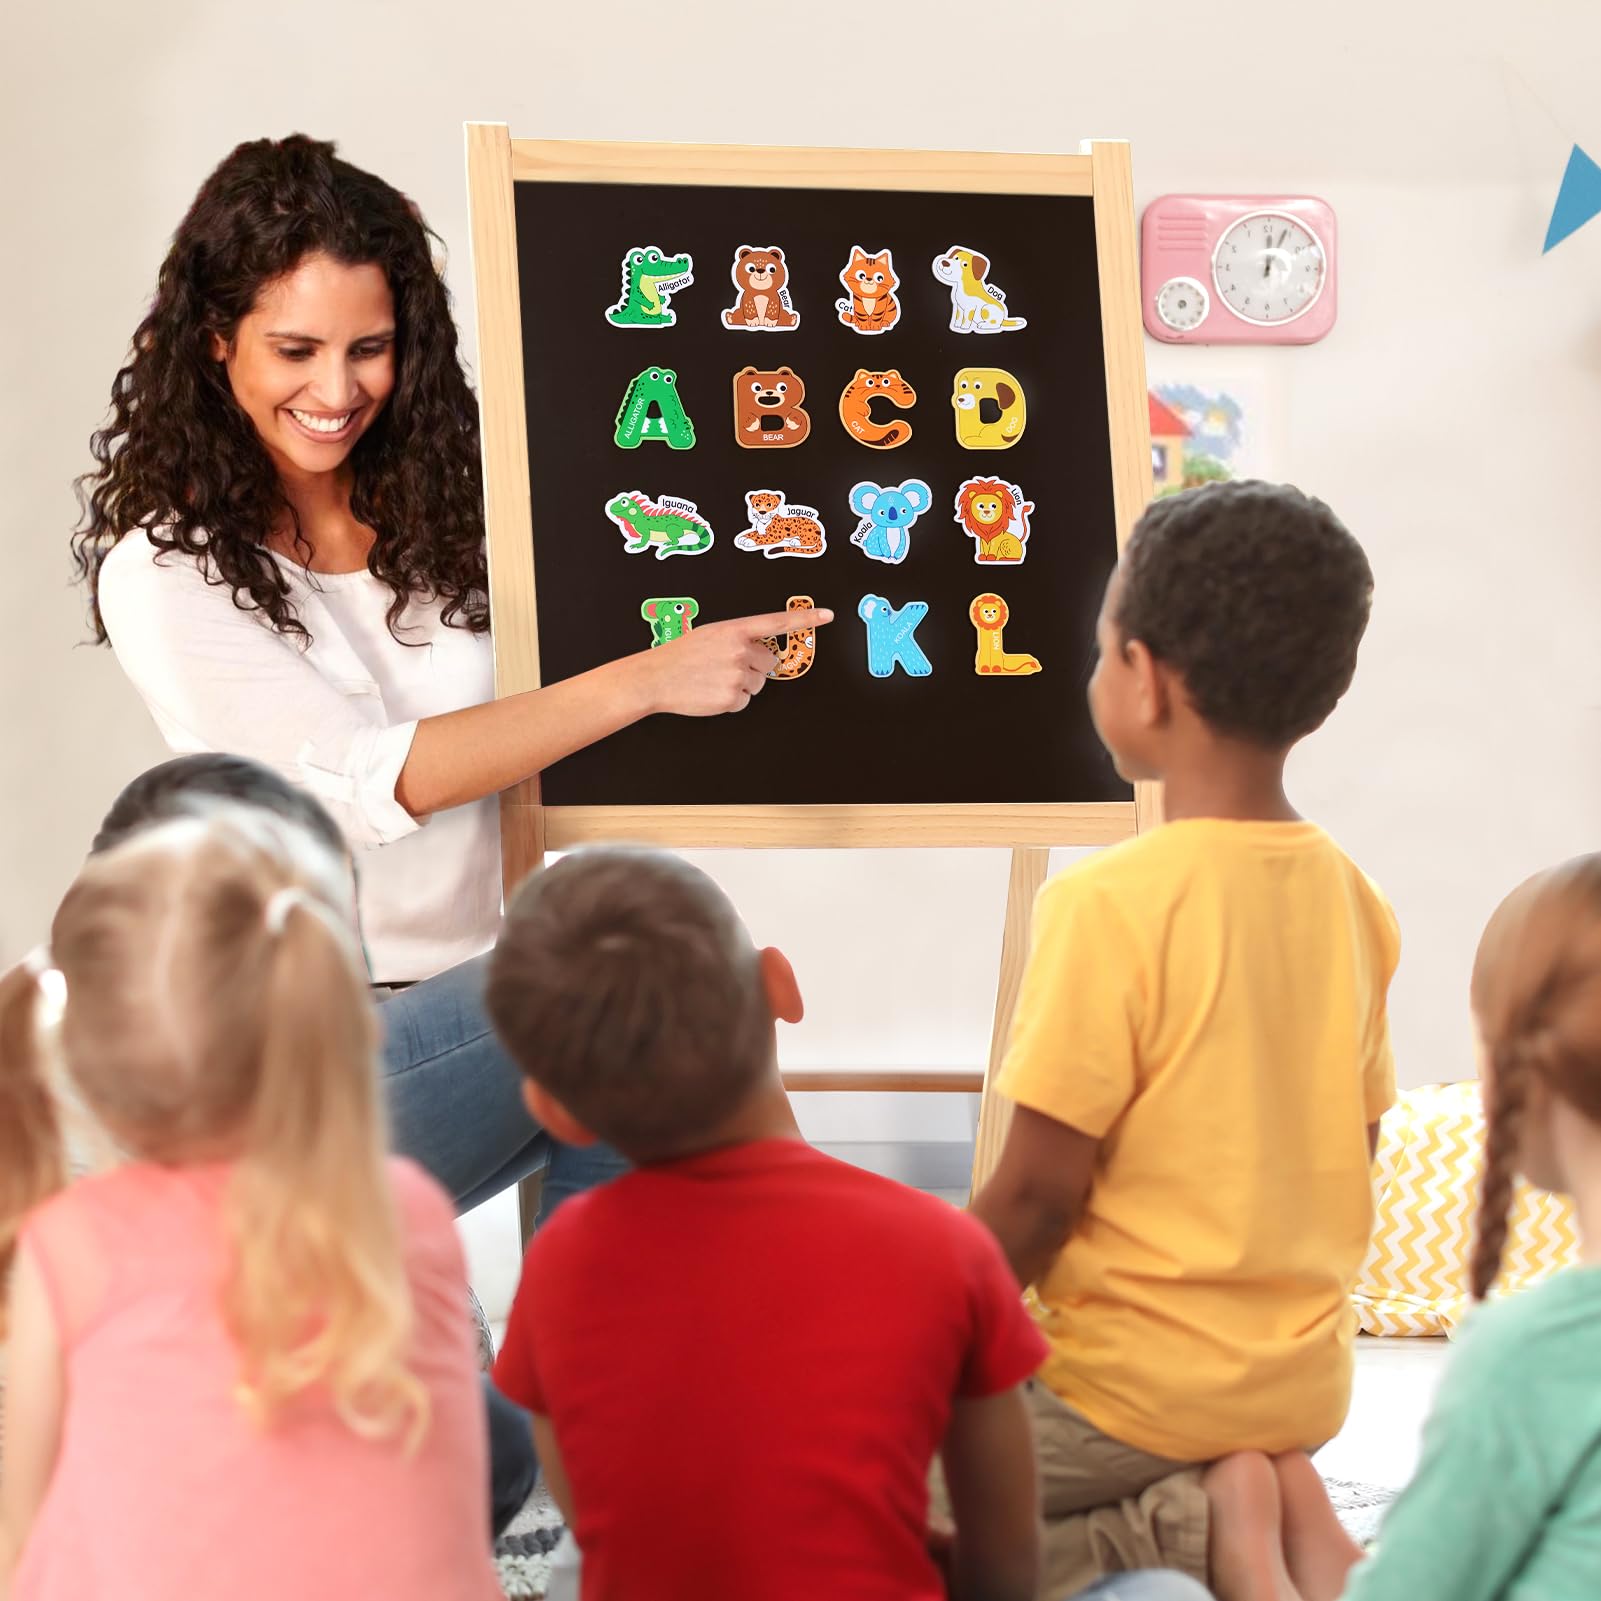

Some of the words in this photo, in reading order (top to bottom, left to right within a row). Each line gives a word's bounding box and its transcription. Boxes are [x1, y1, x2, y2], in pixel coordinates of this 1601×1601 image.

[658, 276, 690, 292] Alligator
[780, 289, 790, 308] Bear
[987, 286, 1003, 301] Dog
[838, 301, 853, 312] Cat
[624, 397, 645, 439] ALLIGATOR
[851, 420, 865, 434] CAT
[763, 433, 784, 441] BEAR
[1011, 488, 1022, 506] Lion
[662, 498, 694, 513] Iguana
[787, 507, 816, 518] Jaguar
[853, 521, 873, 543] Koala
[664, 627, 672, 642] IGU
[894, 621, 913, 645] KOALA
[992, 631, 1000, 650] LION
[778, 650, 804, 671] JAGUAR
